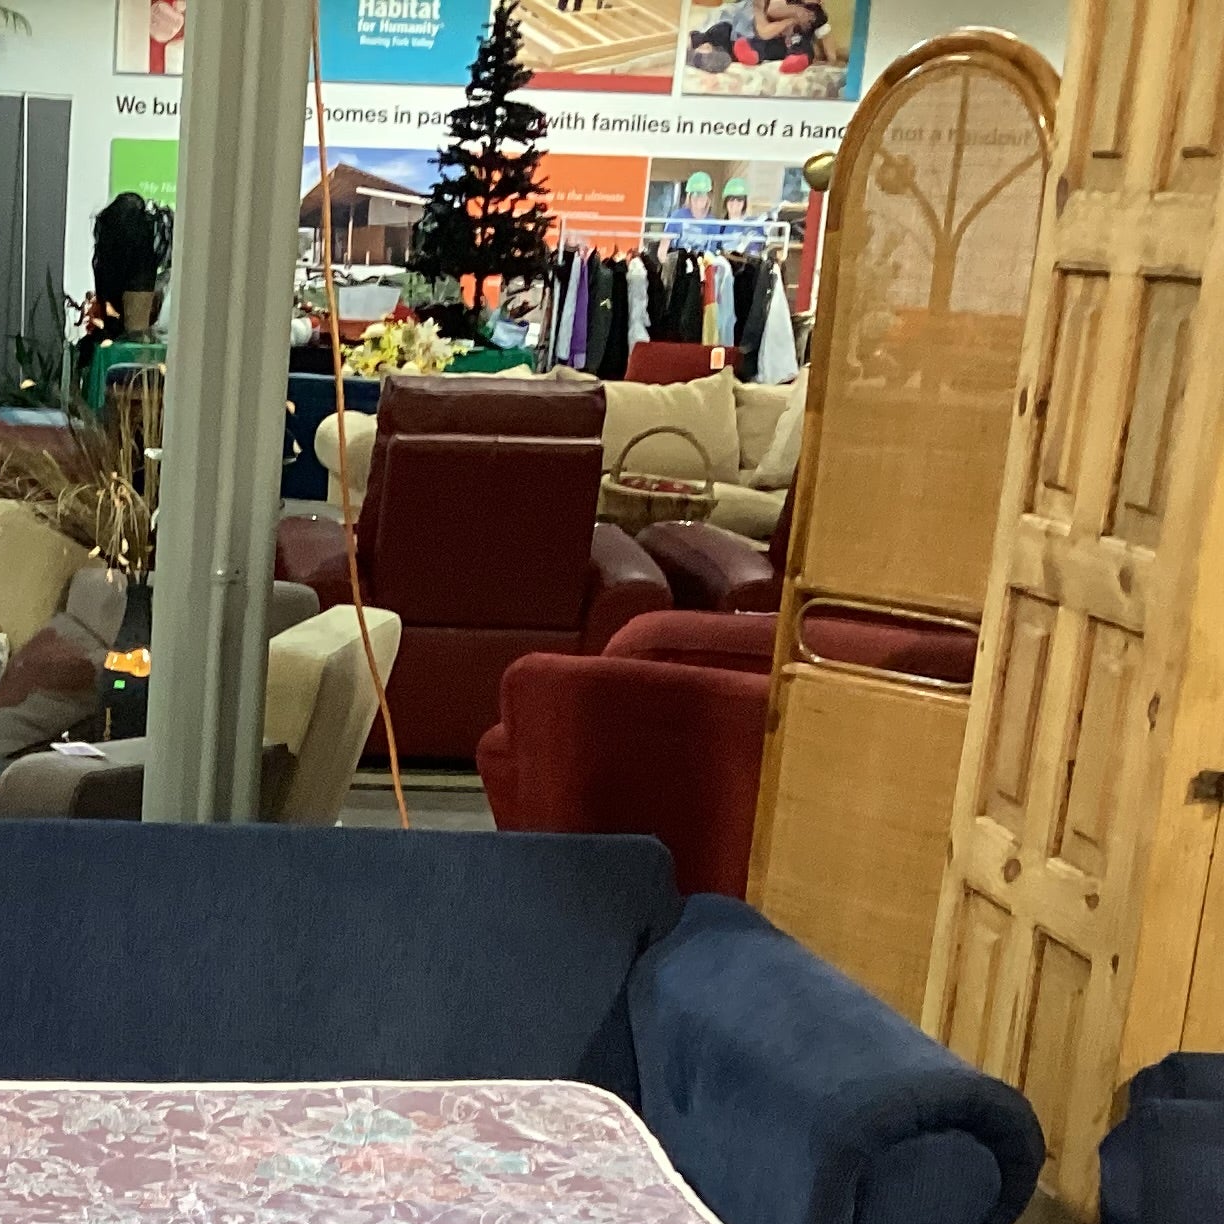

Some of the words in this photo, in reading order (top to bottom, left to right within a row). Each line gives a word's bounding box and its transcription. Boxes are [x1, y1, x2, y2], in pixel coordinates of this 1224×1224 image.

[358, 0, 441, 19] Habitat
[358, 18, 376, 33] for
[379, 20, 439, 37] Humanity
[116, 95, 146, 115] We
[393, 105, 411, 125] in
[544, 111, 585, 130] with
[592, 112, 670, 133] families
[677, 115, 694, 134] in
[700, 117, 751, 136] need
[756, 118, 778, 137] of
[782, 124, 793, 138] a
[947, 127, 1033, 146] hndout
